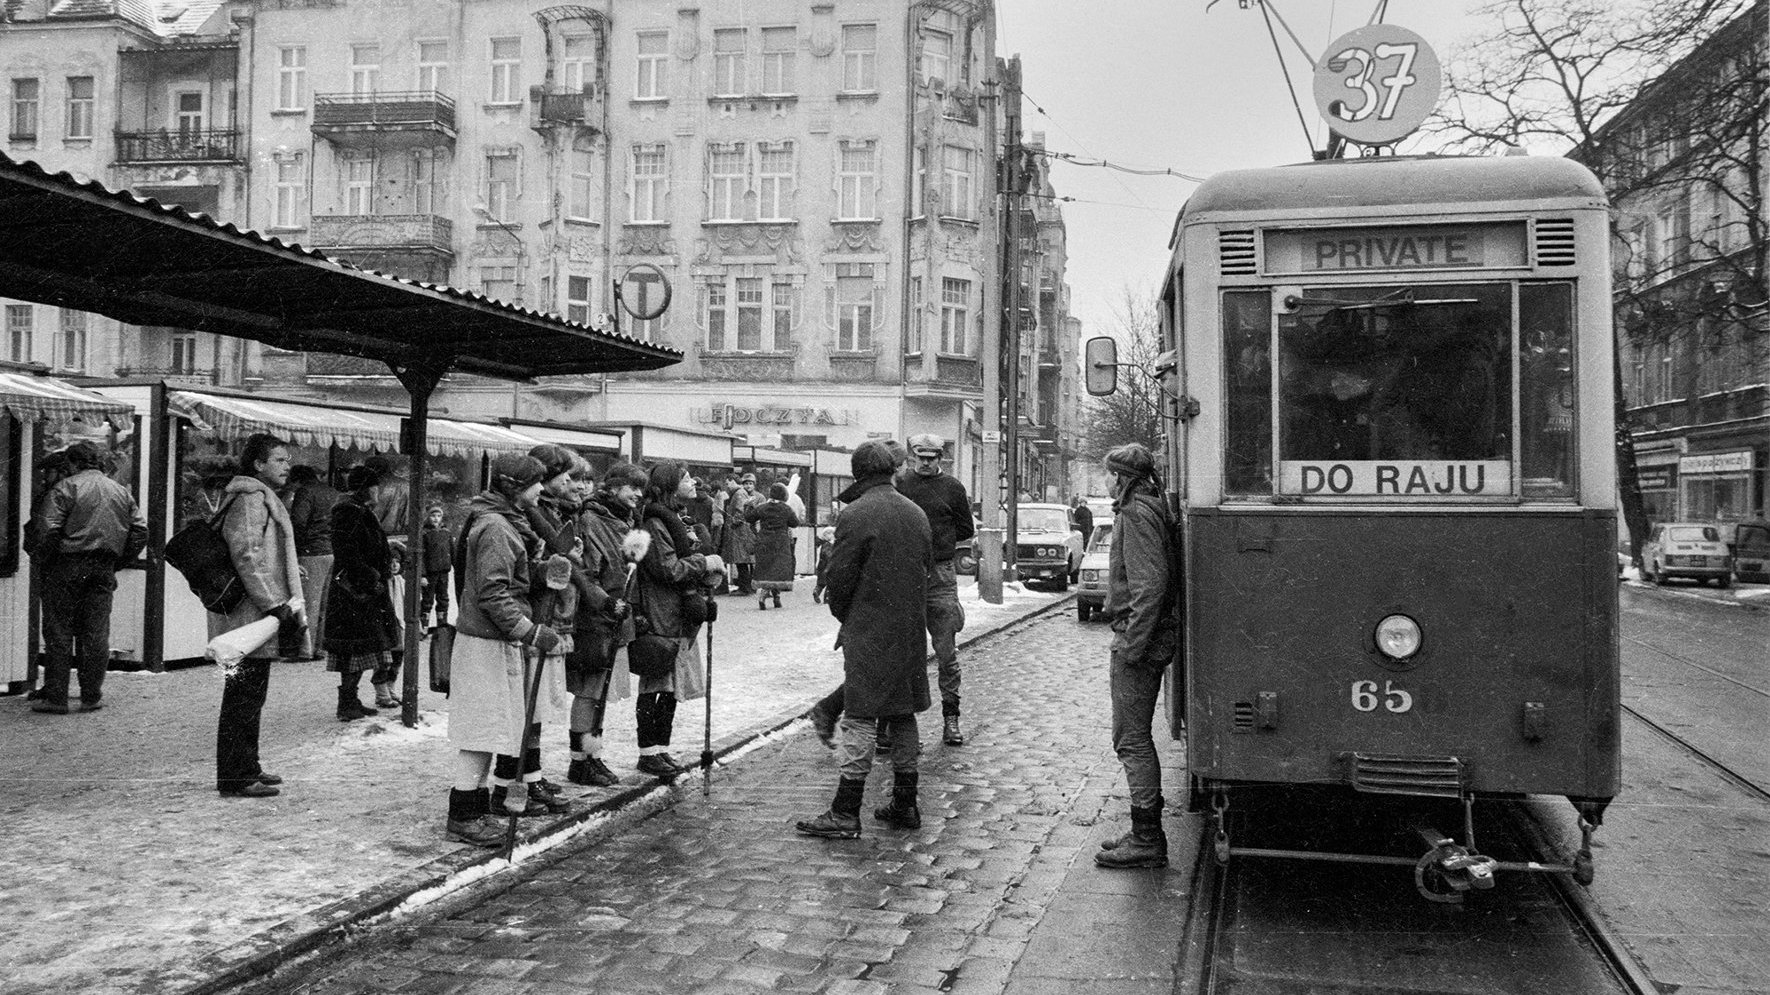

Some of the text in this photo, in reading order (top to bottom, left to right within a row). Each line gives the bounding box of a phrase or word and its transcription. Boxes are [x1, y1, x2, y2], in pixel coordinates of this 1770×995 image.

[1328, 42, 1418, 122] 37
[1315, 234, 1468, 268] PRIVATE
[628, 272, 660, 318] T
[1301, 464, 1485, 494] DO RAJU
[1351, 680, 1413, 713] 65
